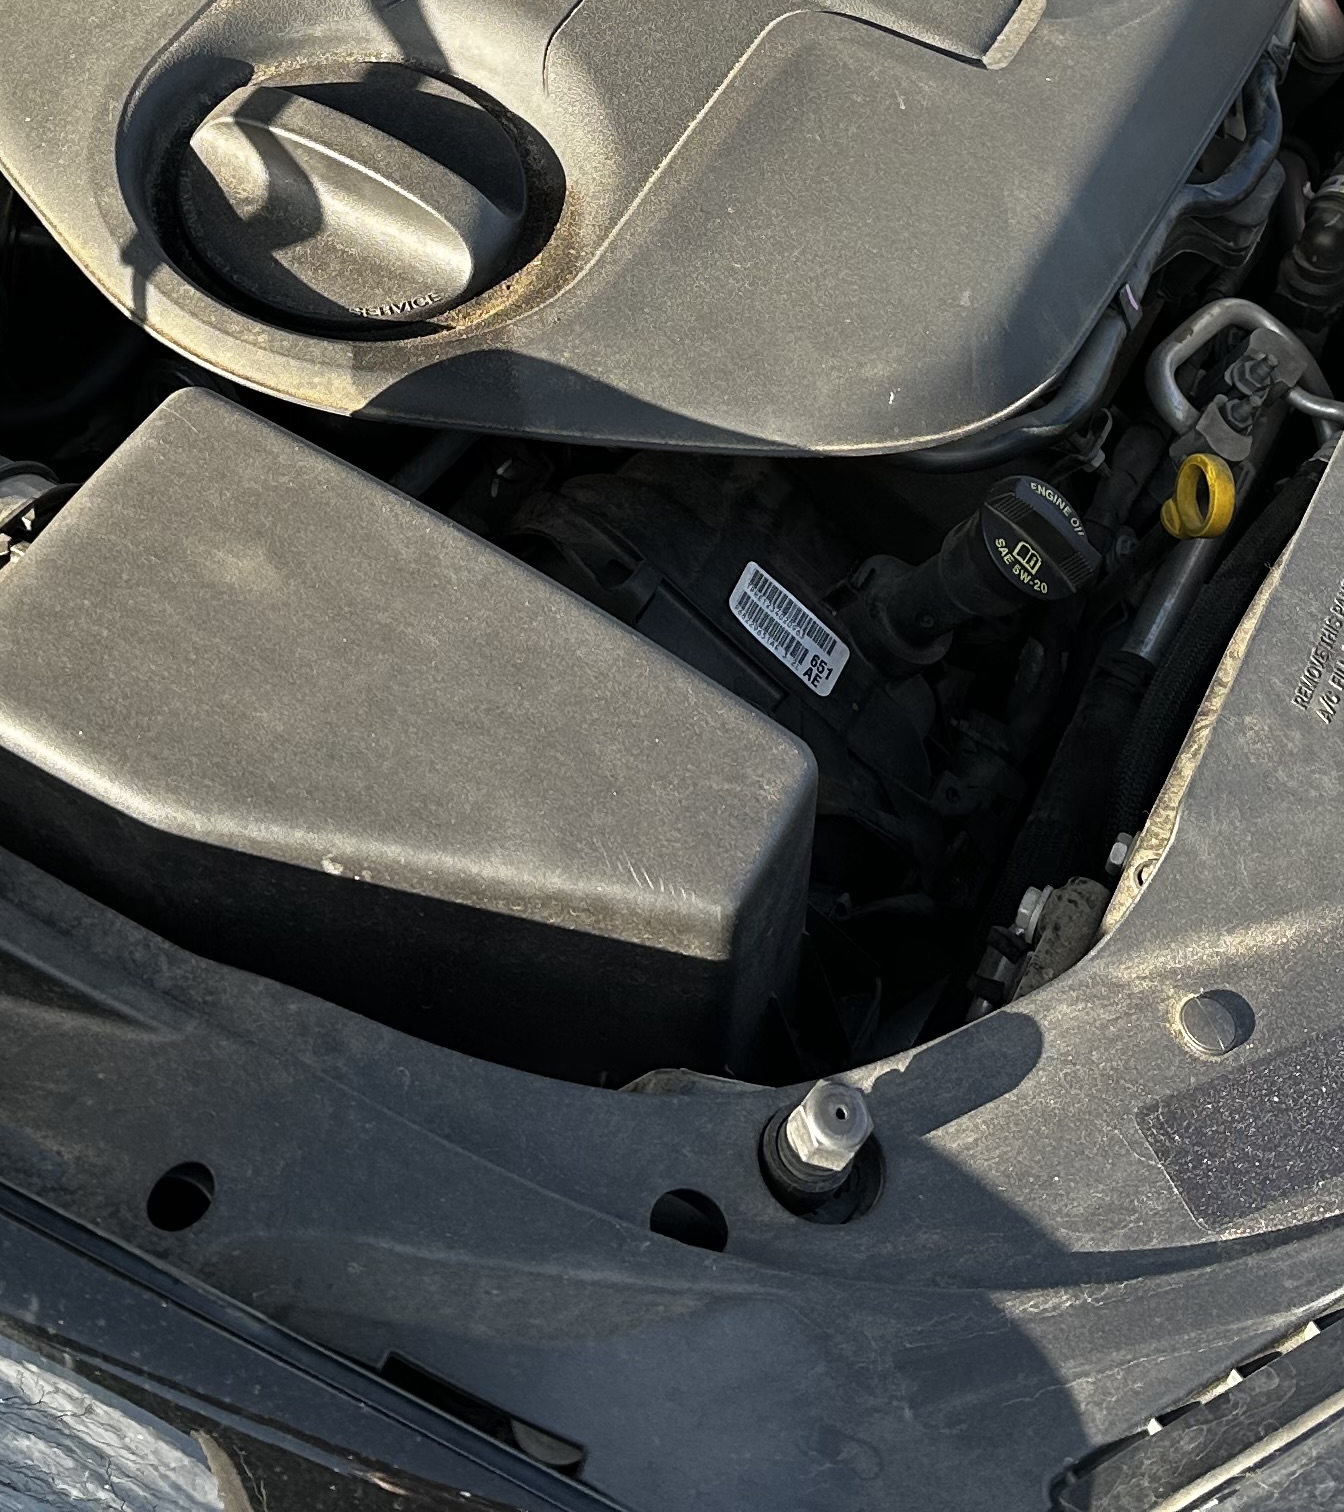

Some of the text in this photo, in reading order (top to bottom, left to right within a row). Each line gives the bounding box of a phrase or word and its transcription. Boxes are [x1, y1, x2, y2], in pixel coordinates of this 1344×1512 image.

[1030, 482, 1073, 517] ENGINE
[995, 538, 1048, 594] SAE 5W-20
[803, 666, 823, 688] AE
[810, 654, 834, 680] 651
[1291, 647, 1329, 710] REMOVE
[1318, 616, 1343, 649] THIS
[1316, 690, 1341, 724] A/C
